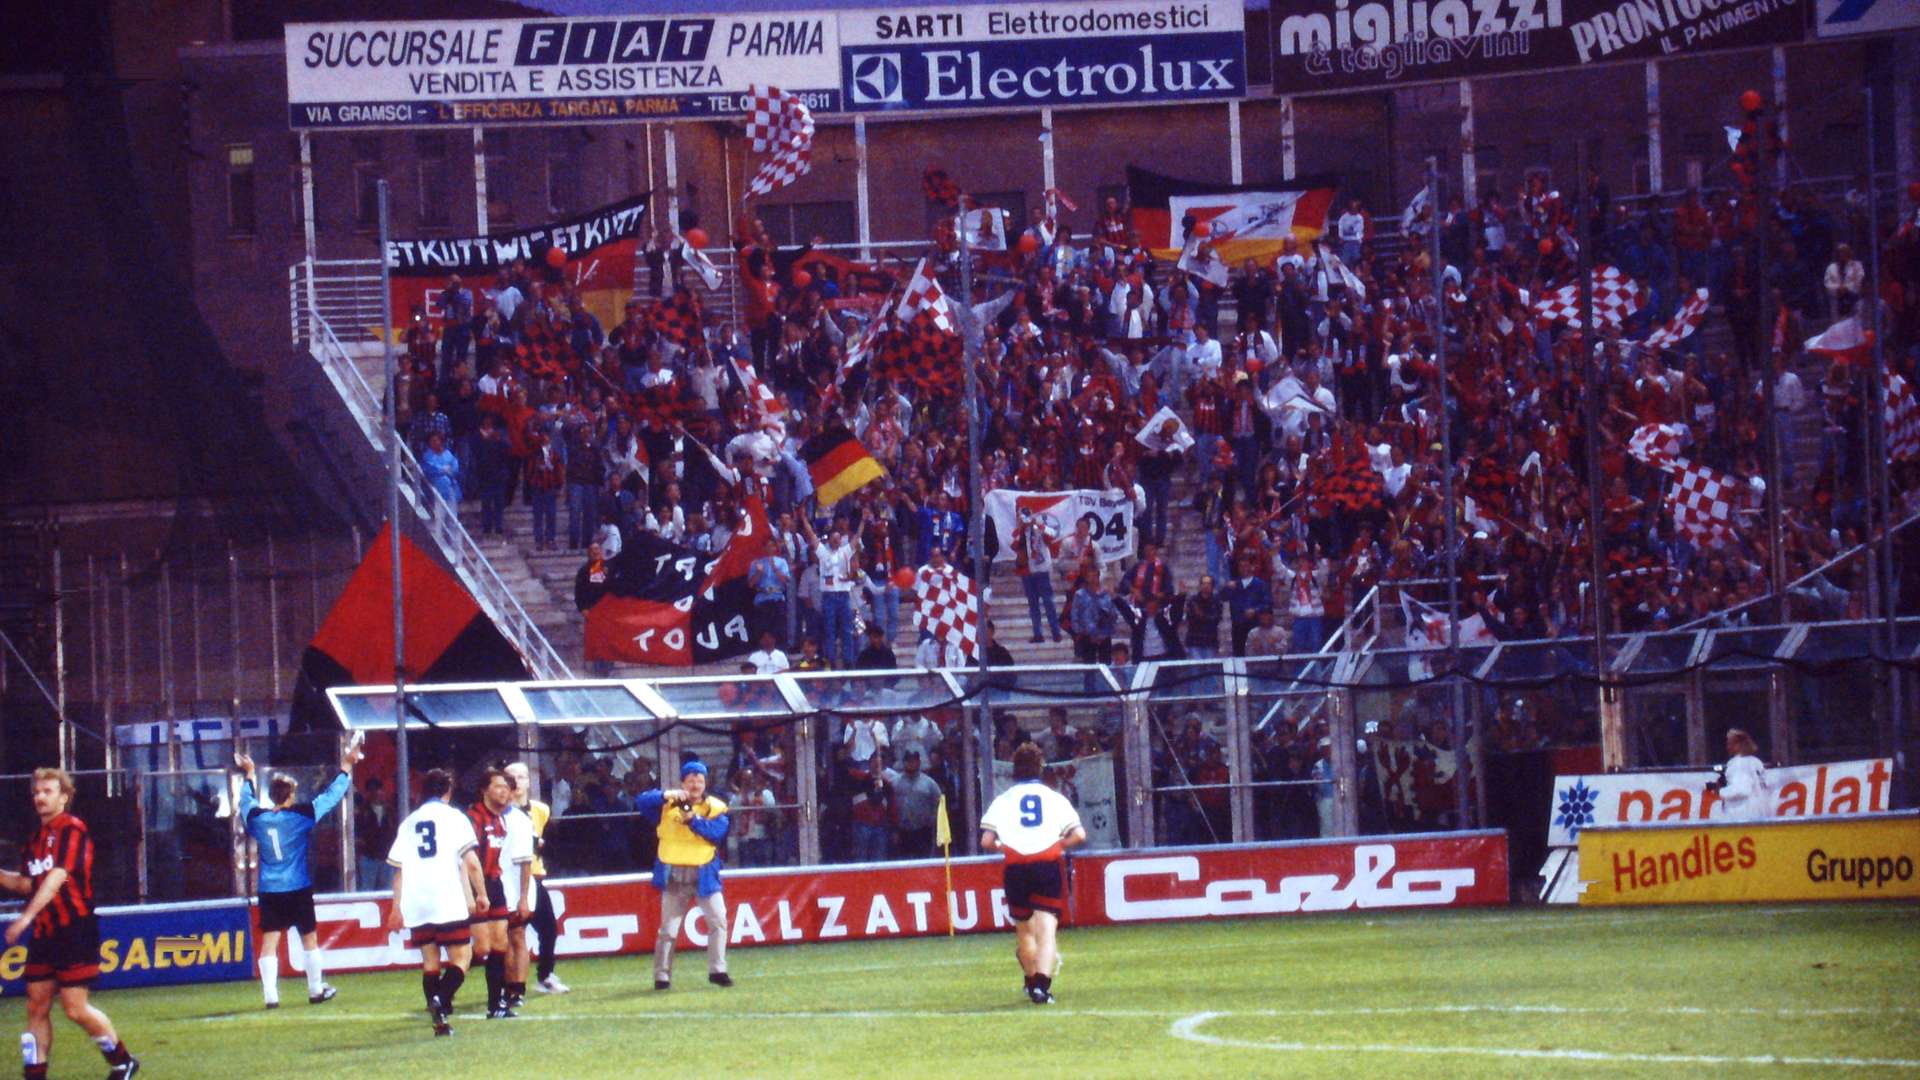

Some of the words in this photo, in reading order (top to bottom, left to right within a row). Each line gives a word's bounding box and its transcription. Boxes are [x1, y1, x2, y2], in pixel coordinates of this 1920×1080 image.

[876, 13, 963, 39] SARTI
[988, 4, 1209, 35] Elettrodomestici
[304, 29, 502, 68] SUCCURSALE
[530, 25, 703, 60] FIAT
[726, 20, 824, 58] PARMA
[1341, 19, 1530, 79] tagliavini
[409, 71, 517, 94] VENDITA
[529, 70, 545, 92] E
[556, 65, 723, 91] ASSISTENZA
[921, 44, 1235, 100] Electrolux
[306, 106, 333, 122] VIA
[338, 103, 413, 121] GRAMSCI
[549, 99, 618, 117] TARGATA
[1020, 794, 1043, 827] 9
[1617, 760, 1889, 823] paralat
[267, 828, 283, 860] 1
[414, 820, 437, 859] 3
[1613, 834, 1757, 892] Handles
[1806, 848, 1913, 890] Gruppo
